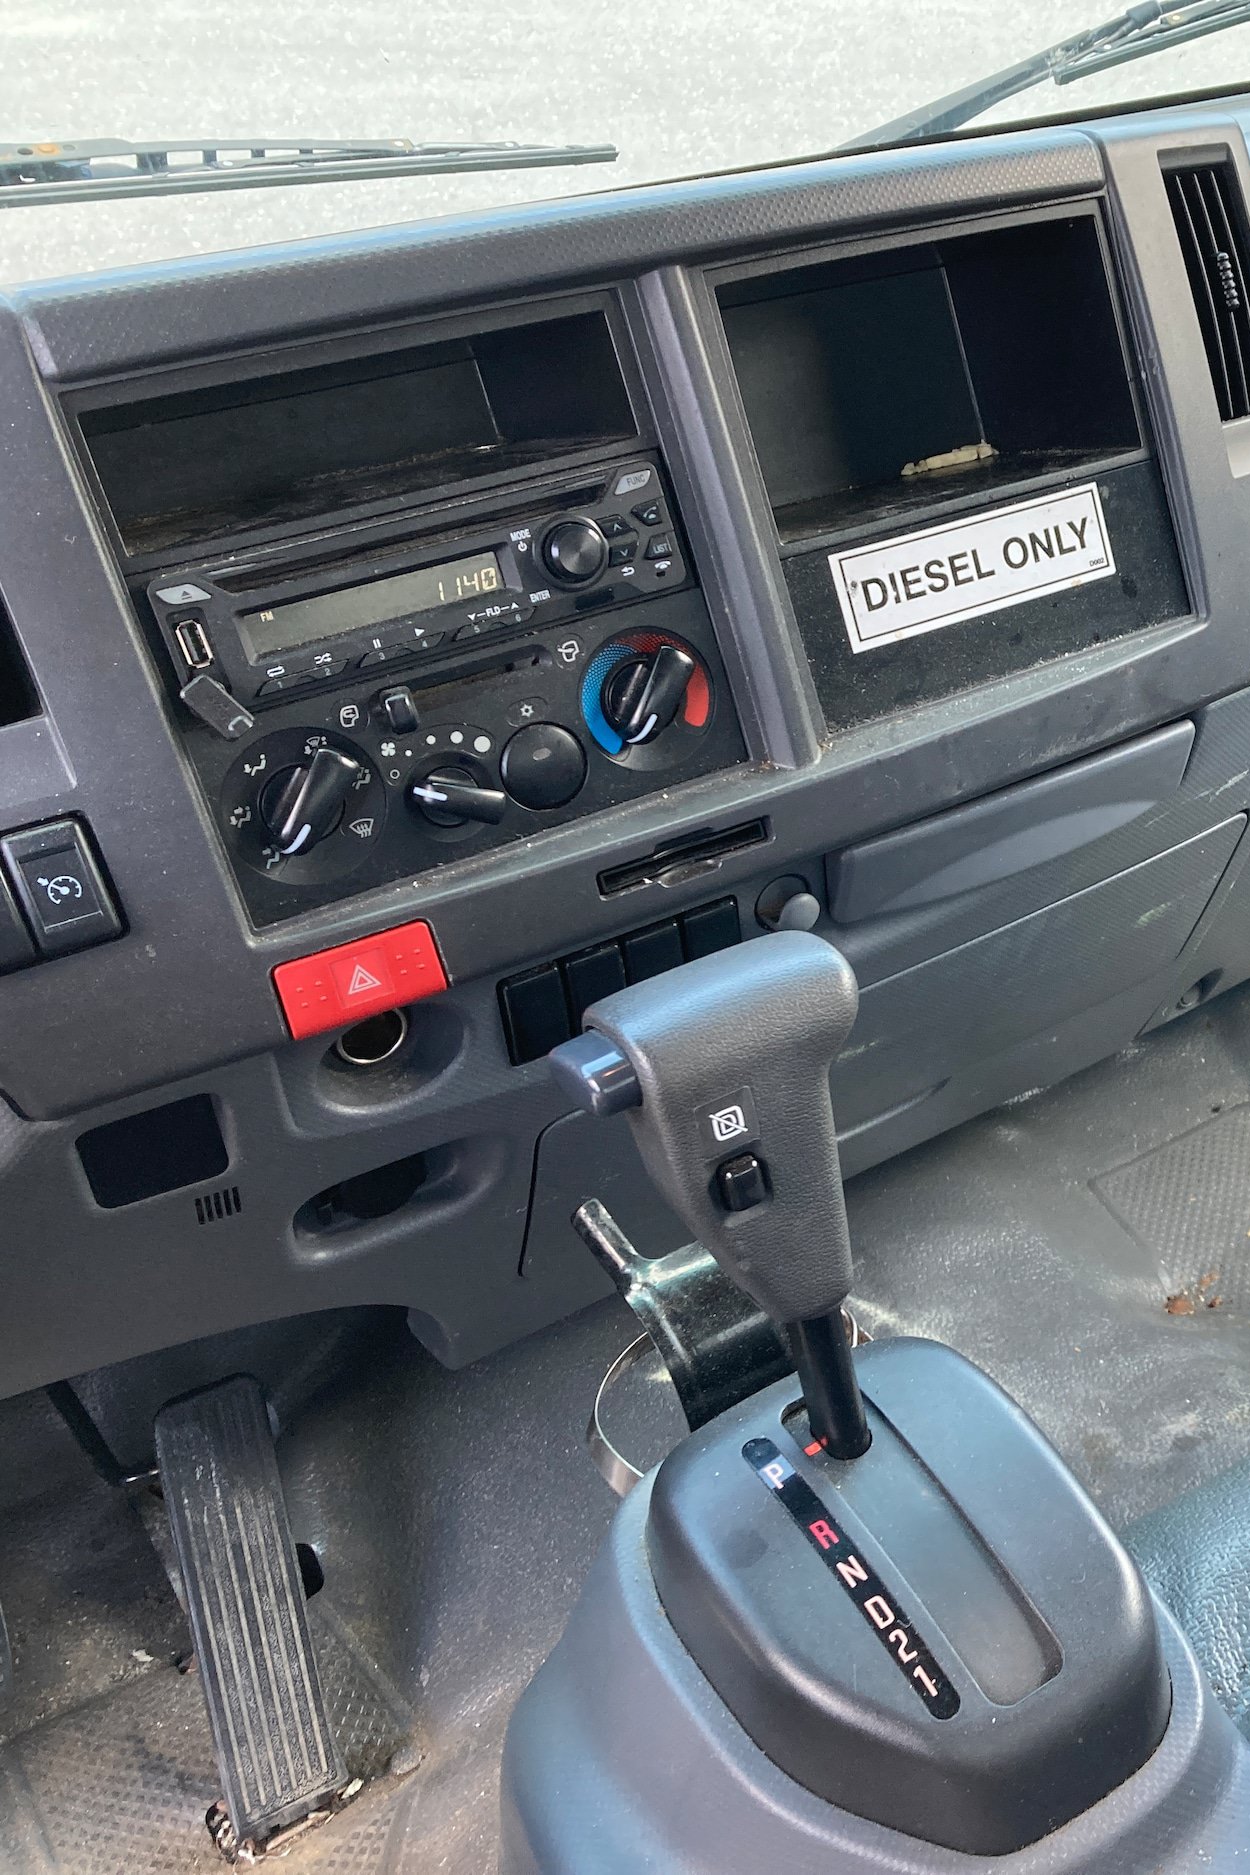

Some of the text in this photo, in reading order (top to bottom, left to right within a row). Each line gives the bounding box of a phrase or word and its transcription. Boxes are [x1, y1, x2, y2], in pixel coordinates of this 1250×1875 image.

[626, 474, 646, 487] FUNC
[509, 528, 531, 542] MODE
[652, 543, 669, 554] LIST
[860, 516, 1088, 613] DIESEL ONLY
[529, 589, 551, 603] ENTER
[260, 611, 274, 623] FM
[485, 605, 501, 618] FLD
[515, 613, 522, 623] 6
[473, 625, 480, 634] 5
[378, 652, 386, 661] 3
[324, 667, 331, 677] 2
[763, 1463, 784, 1489] P
[809, 1519, 840, 1550] R
[835, 1554, 869, 1589] N
[863, 1594, 895, 1629] D
[888, 1628, 918, 1664] 2
[912, 1664, 938, 1697] 1
